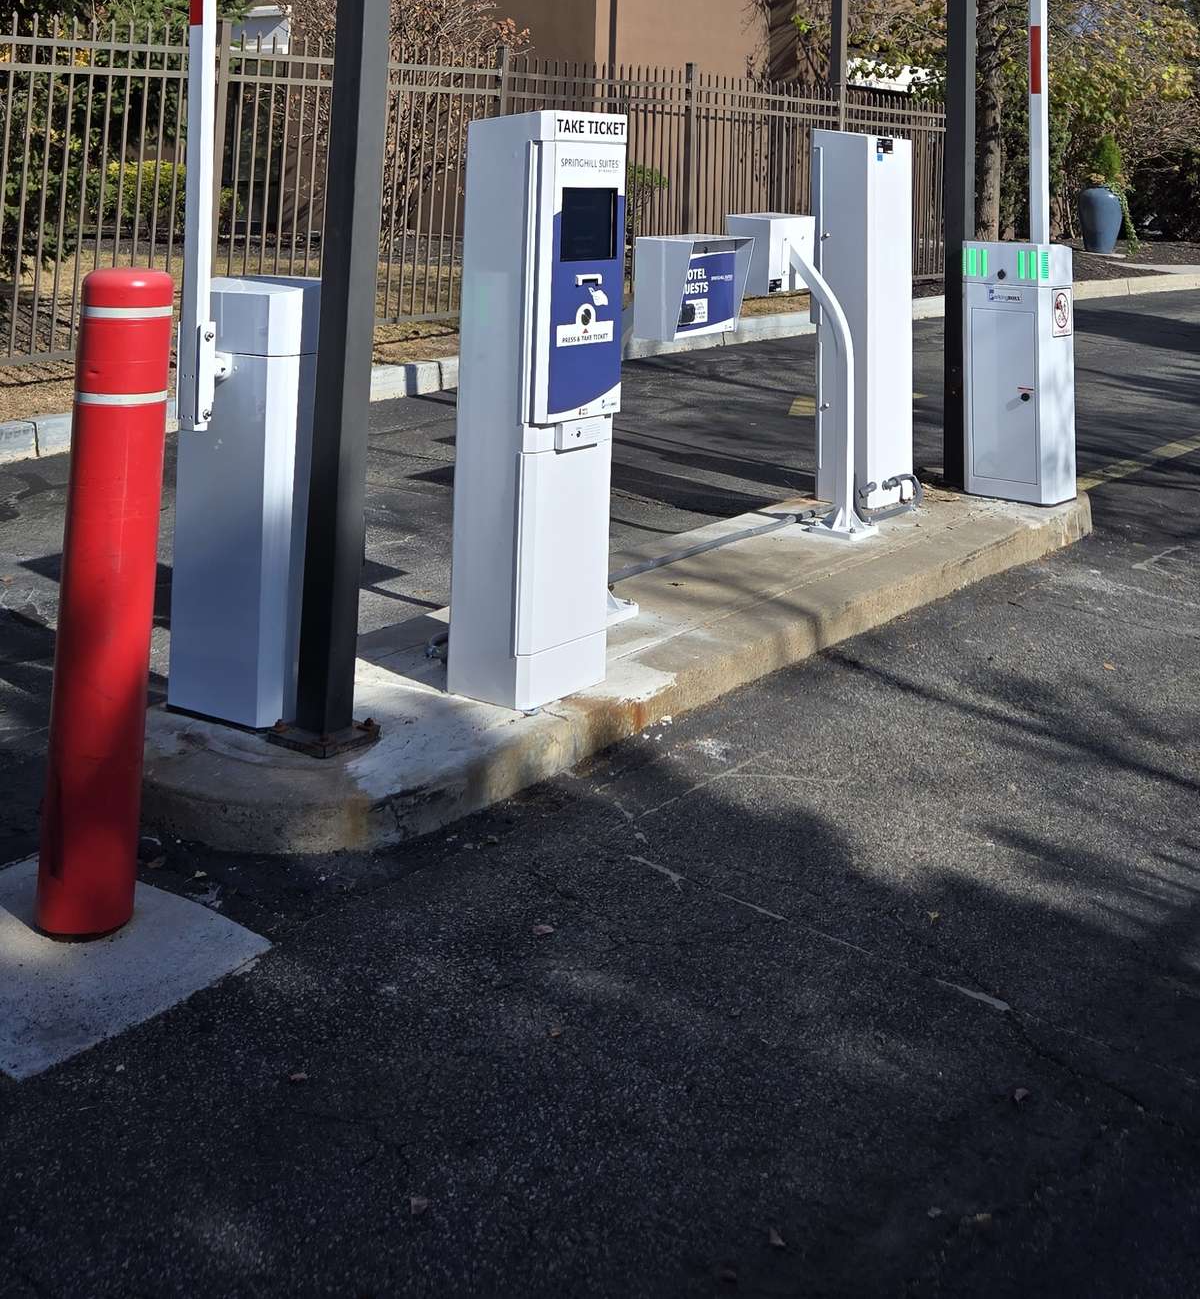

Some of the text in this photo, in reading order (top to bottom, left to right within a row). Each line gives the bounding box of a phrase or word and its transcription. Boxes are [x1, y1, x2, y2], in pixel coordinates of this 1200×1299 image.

[557, 119, 625, 136] TAKE TICKET
[560, 157, 619, 169] SPRINGHILL SUITES
[687, 268, 707, 280] OTEL
[684, 282, 709, 295] UESTS
[593, 332, 609, 340] TICKET
